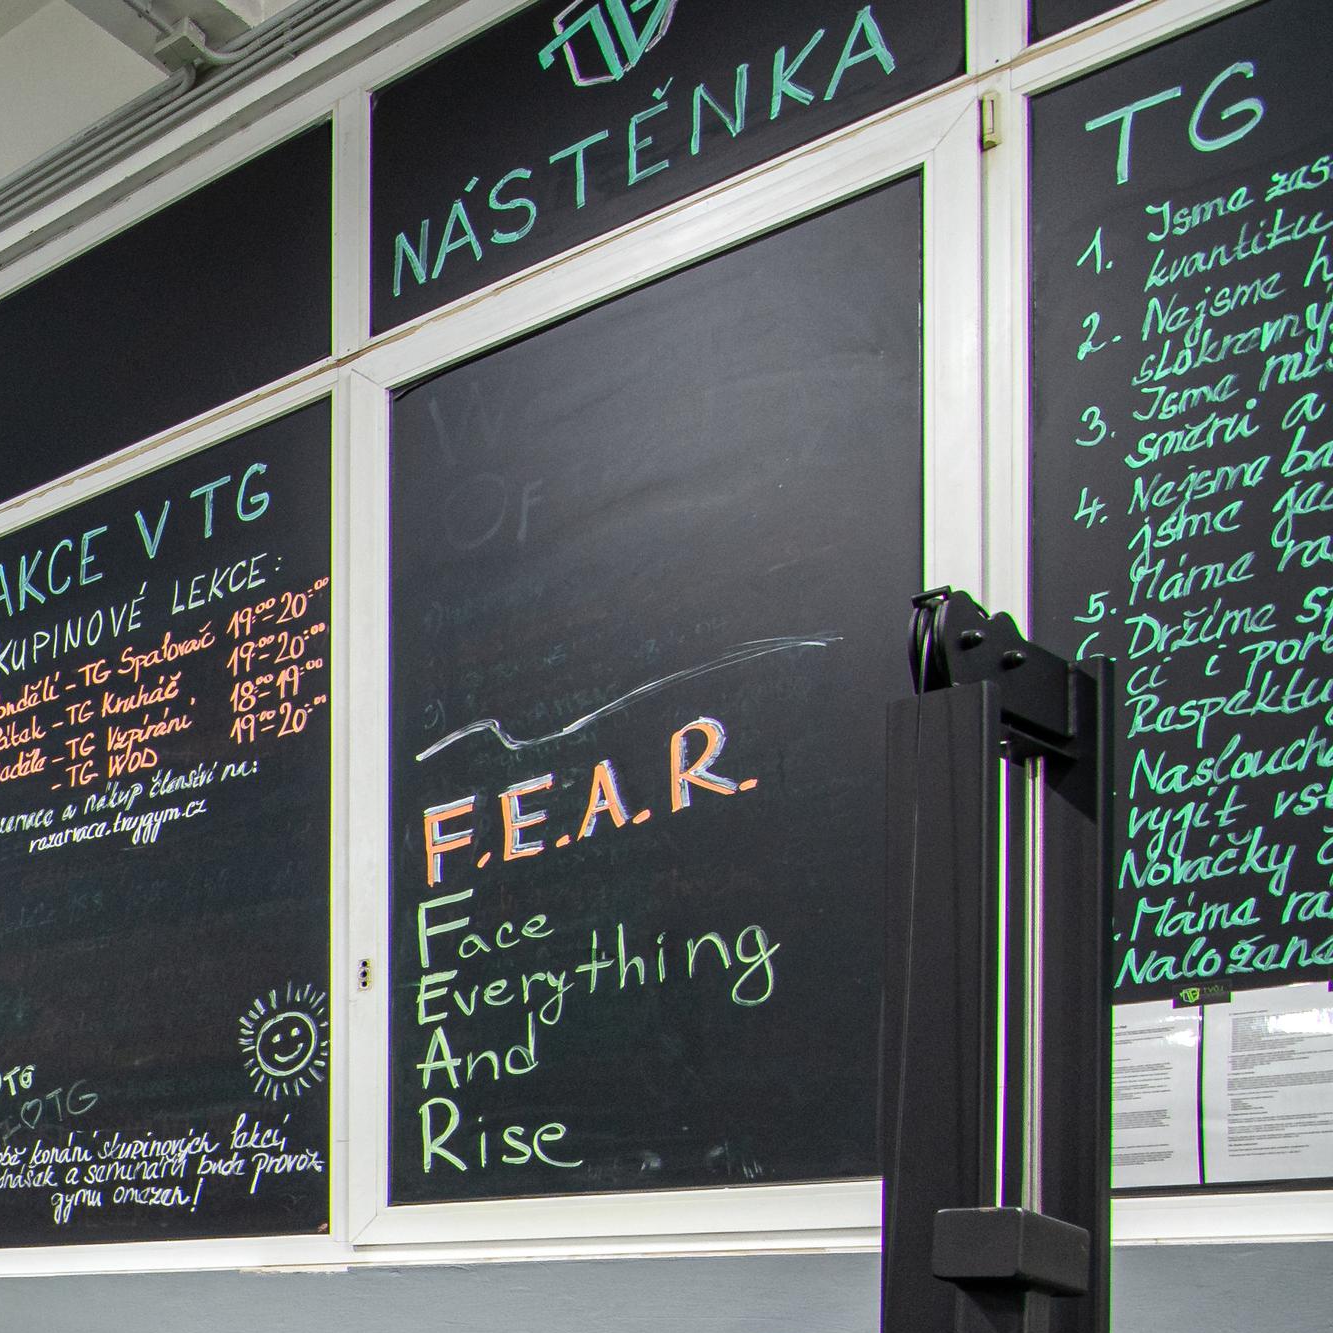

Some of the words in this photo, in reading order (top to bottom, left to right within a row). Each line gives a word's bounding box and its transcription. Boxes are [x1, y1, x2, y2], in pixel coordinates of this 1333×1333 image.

[1085, 61, 1265, 185] TG
[392, 4, 896, 297] NÁSTĚNKA
[1077, 226, 1113, 274] 1.
[1077, 312, 1122, 361] 2.
[1076, 405, 1115, 446] 3.
[135, 500, 170, 558] V
[190, 463, 270, 538] TG
[1073, 487, 1108, 530] 4.
[1074, 591, 1117, 623] 5.
[78, 659, 112, 686] TG
[65, 700, 94, 725] TG
[65, 732, 96, 760] TG
[65, 760, 99, 788] TG
[108, 748, 158, 778] WOD
[418, 889, 555, 968] Face
[417, 923, 780, 1026] Everything
[415, 1011, 539, 1090] And
[418, 1096, 584, 1173] Rise
